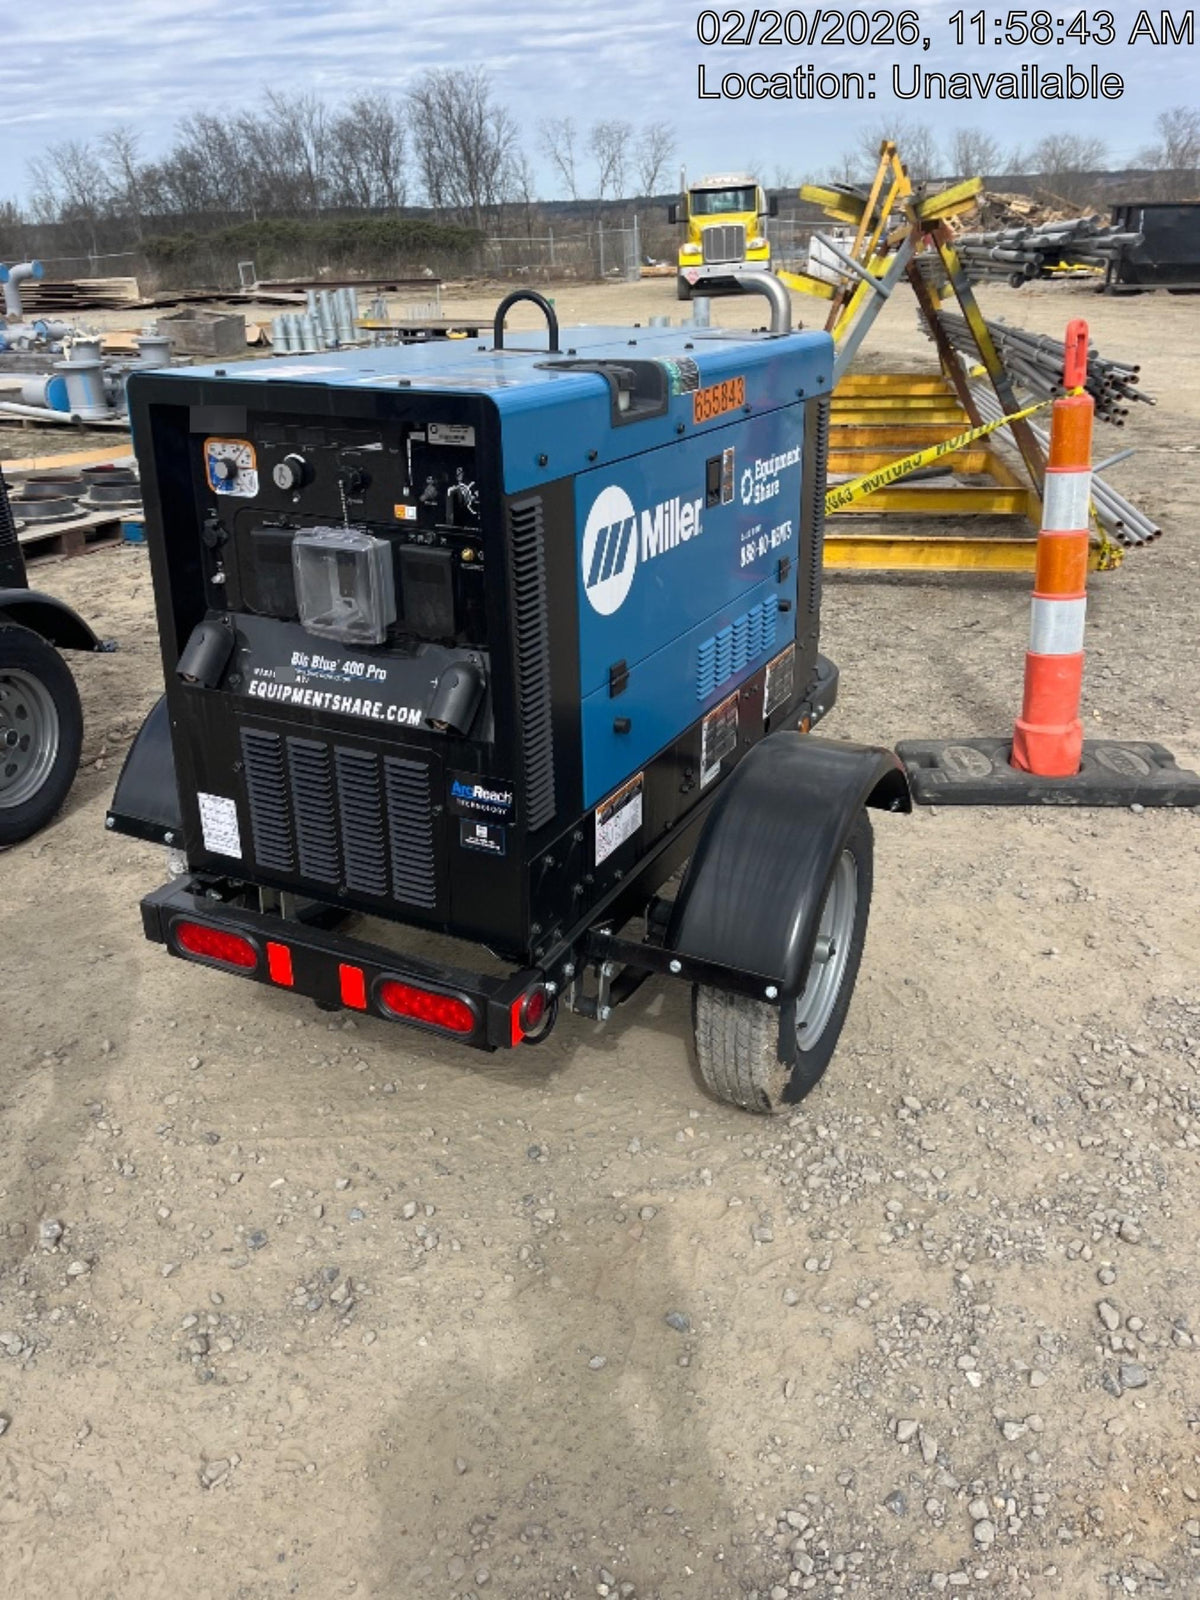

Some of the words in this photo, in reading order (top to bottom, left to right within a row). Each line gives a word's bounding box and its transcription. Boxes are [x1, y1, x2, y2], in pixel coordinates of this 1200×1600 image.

[694, 377, 744, 422] 655843
[755, 445, 801, 481] Equipment
[753, 480, 780, 505] Share
[641, 496, 703, 563] Miller
[291, 651, 310, 667] Big
[342, 660, 365, 678] 400
[366, 664, 387, 680] Pro
[248, 680, 422, 726] EQUIPMENTSHARE.COM
